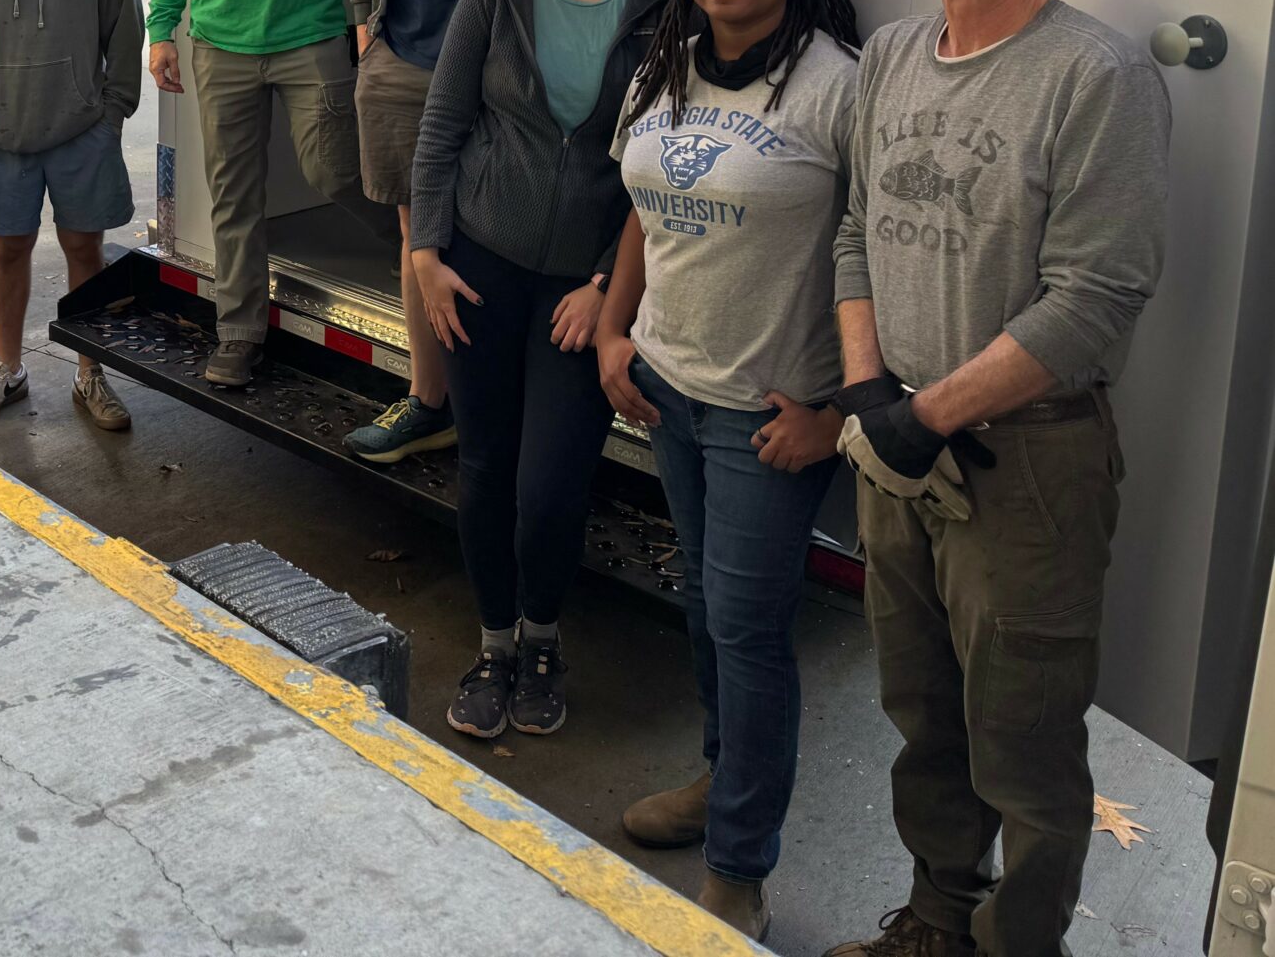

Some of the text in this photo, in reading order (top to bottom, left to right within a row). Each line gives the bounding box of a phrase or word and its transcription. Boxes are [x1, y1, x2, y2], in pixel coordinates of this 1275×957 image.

[722, 111, 786, 156] STATE
[878, 111, 1006, 164] LIFE IS
[629, 186, 746, 227] UNIVERSITY
[684, 224, 697, 234] 1913
[877, 215, 968, 255] GOOD
[386, 357, 408, 373] CAM
